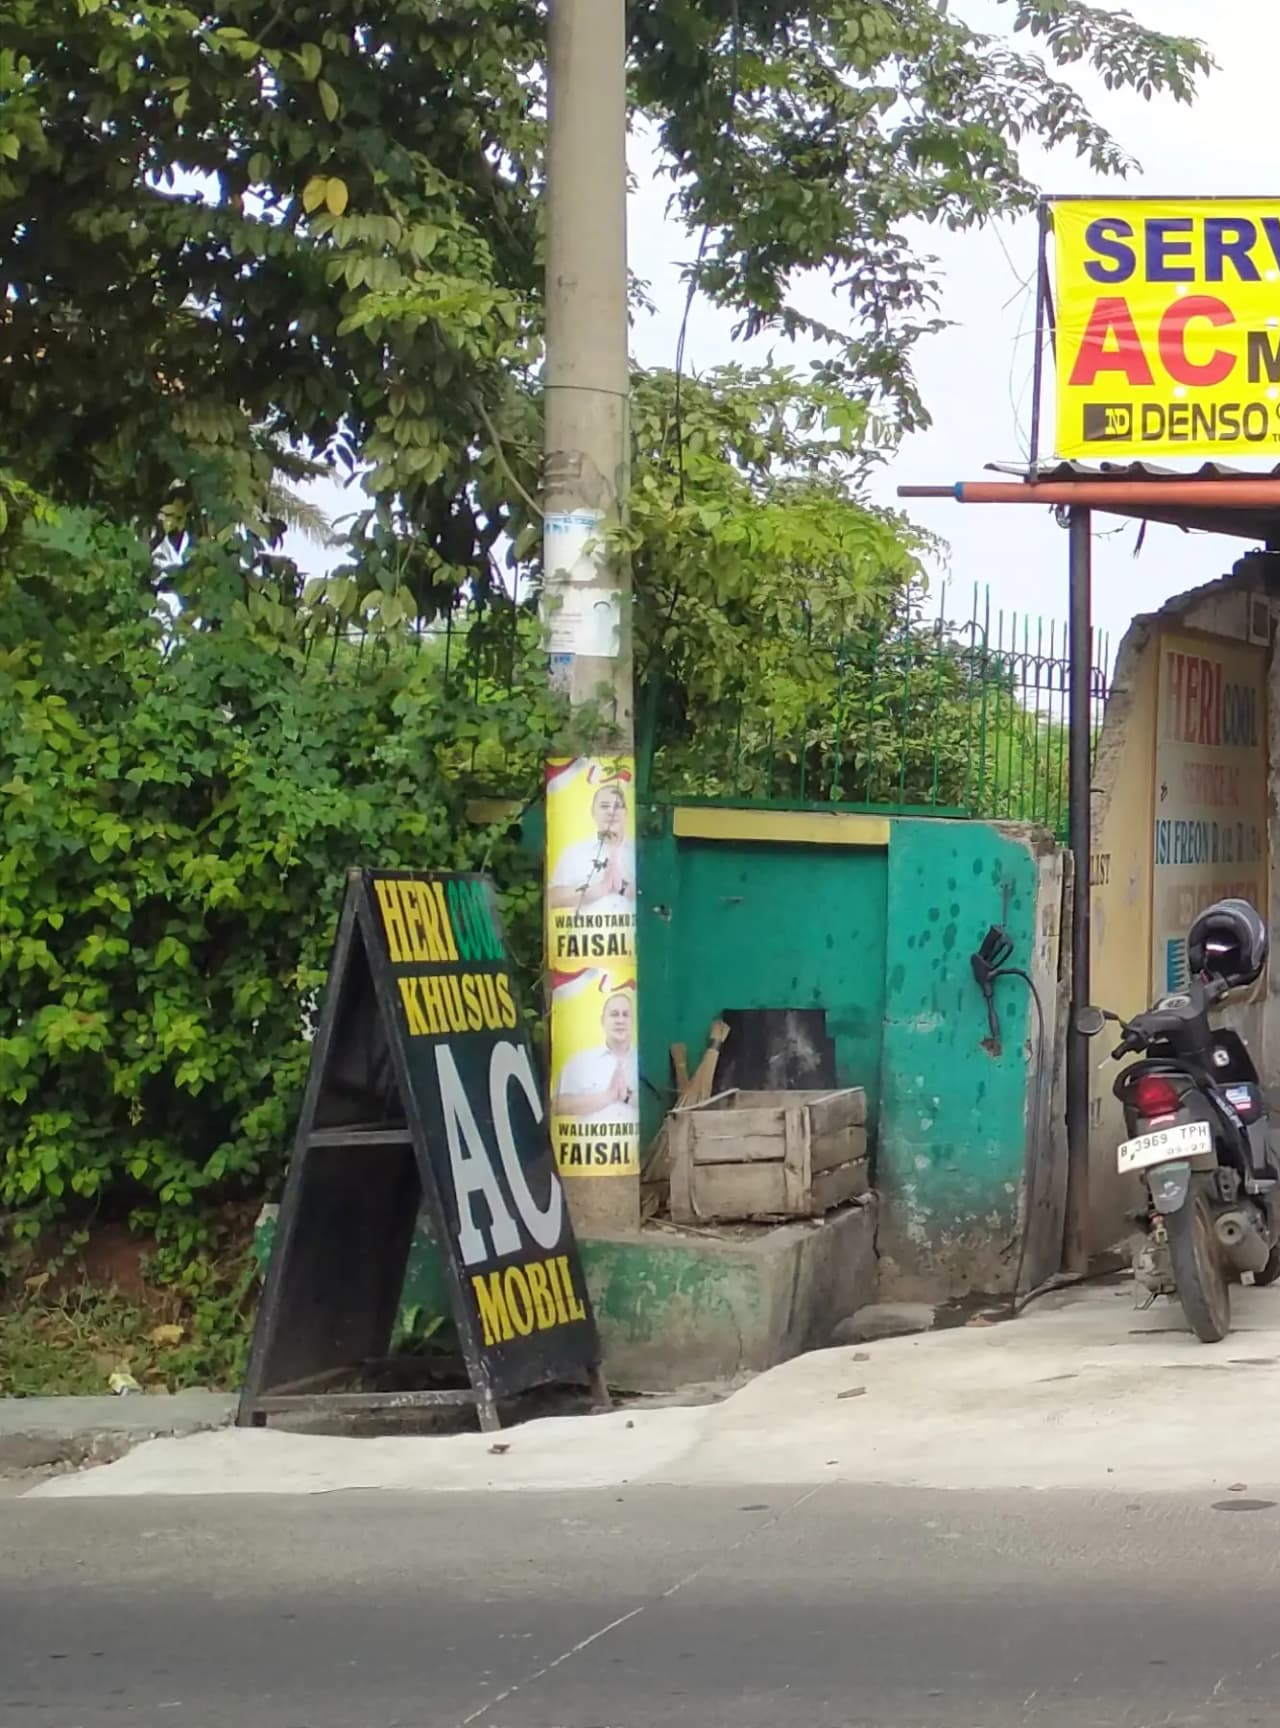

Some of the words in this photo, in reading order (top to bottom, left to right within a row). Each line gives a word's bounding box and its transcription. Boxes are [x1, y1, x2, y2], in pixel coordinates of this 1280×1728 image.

[1068, 295, 1237, 387] AC
[1141, 402, 1269, 442] DENSO
[1167, 651, 1222, 746] HERI
[1155, 820, 1172, 864] ISI
[1174, 820, 1209, 865] FREON
[374, 879, 459, 963] HERI
[397, 972, 517, 1036] KHUSUS
[434, 1040, 562, 1266] AC
[1180, 1126, 1207, 1140] TPH
[472, 1255, 587, 1347] MOBIL
